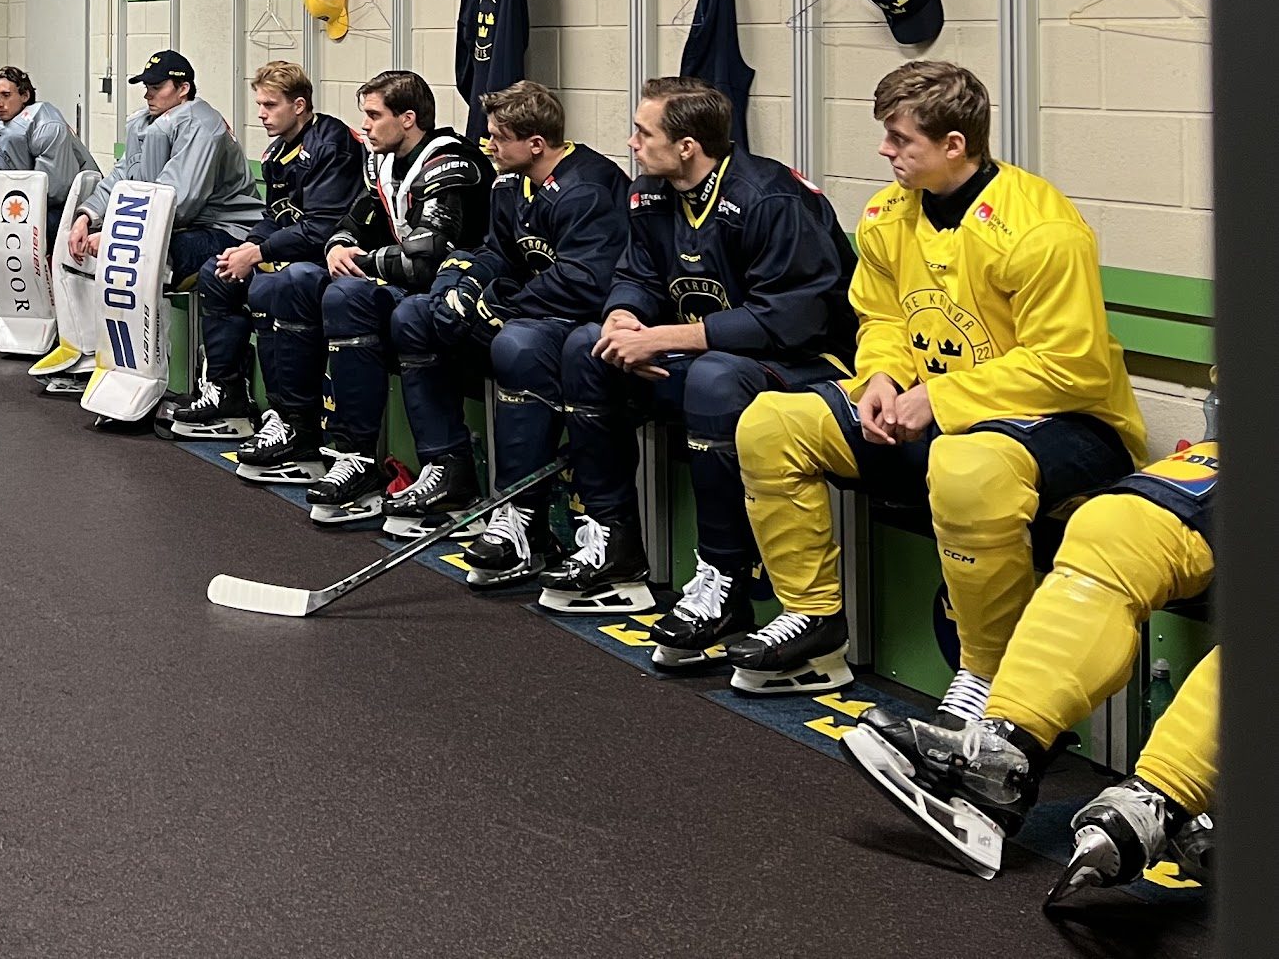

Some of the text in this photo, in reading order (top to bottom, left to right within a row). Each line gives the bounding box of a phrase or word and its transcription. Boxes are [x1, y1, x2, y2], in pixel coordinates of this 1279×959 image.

[104, 193, 151, 311] NOCCO
[924, 260, 947, 270] CM
[5, 233, 31, 313] COOR
[976, 347, 991, 361] 22
[943, 549, 976, 564] CCM
